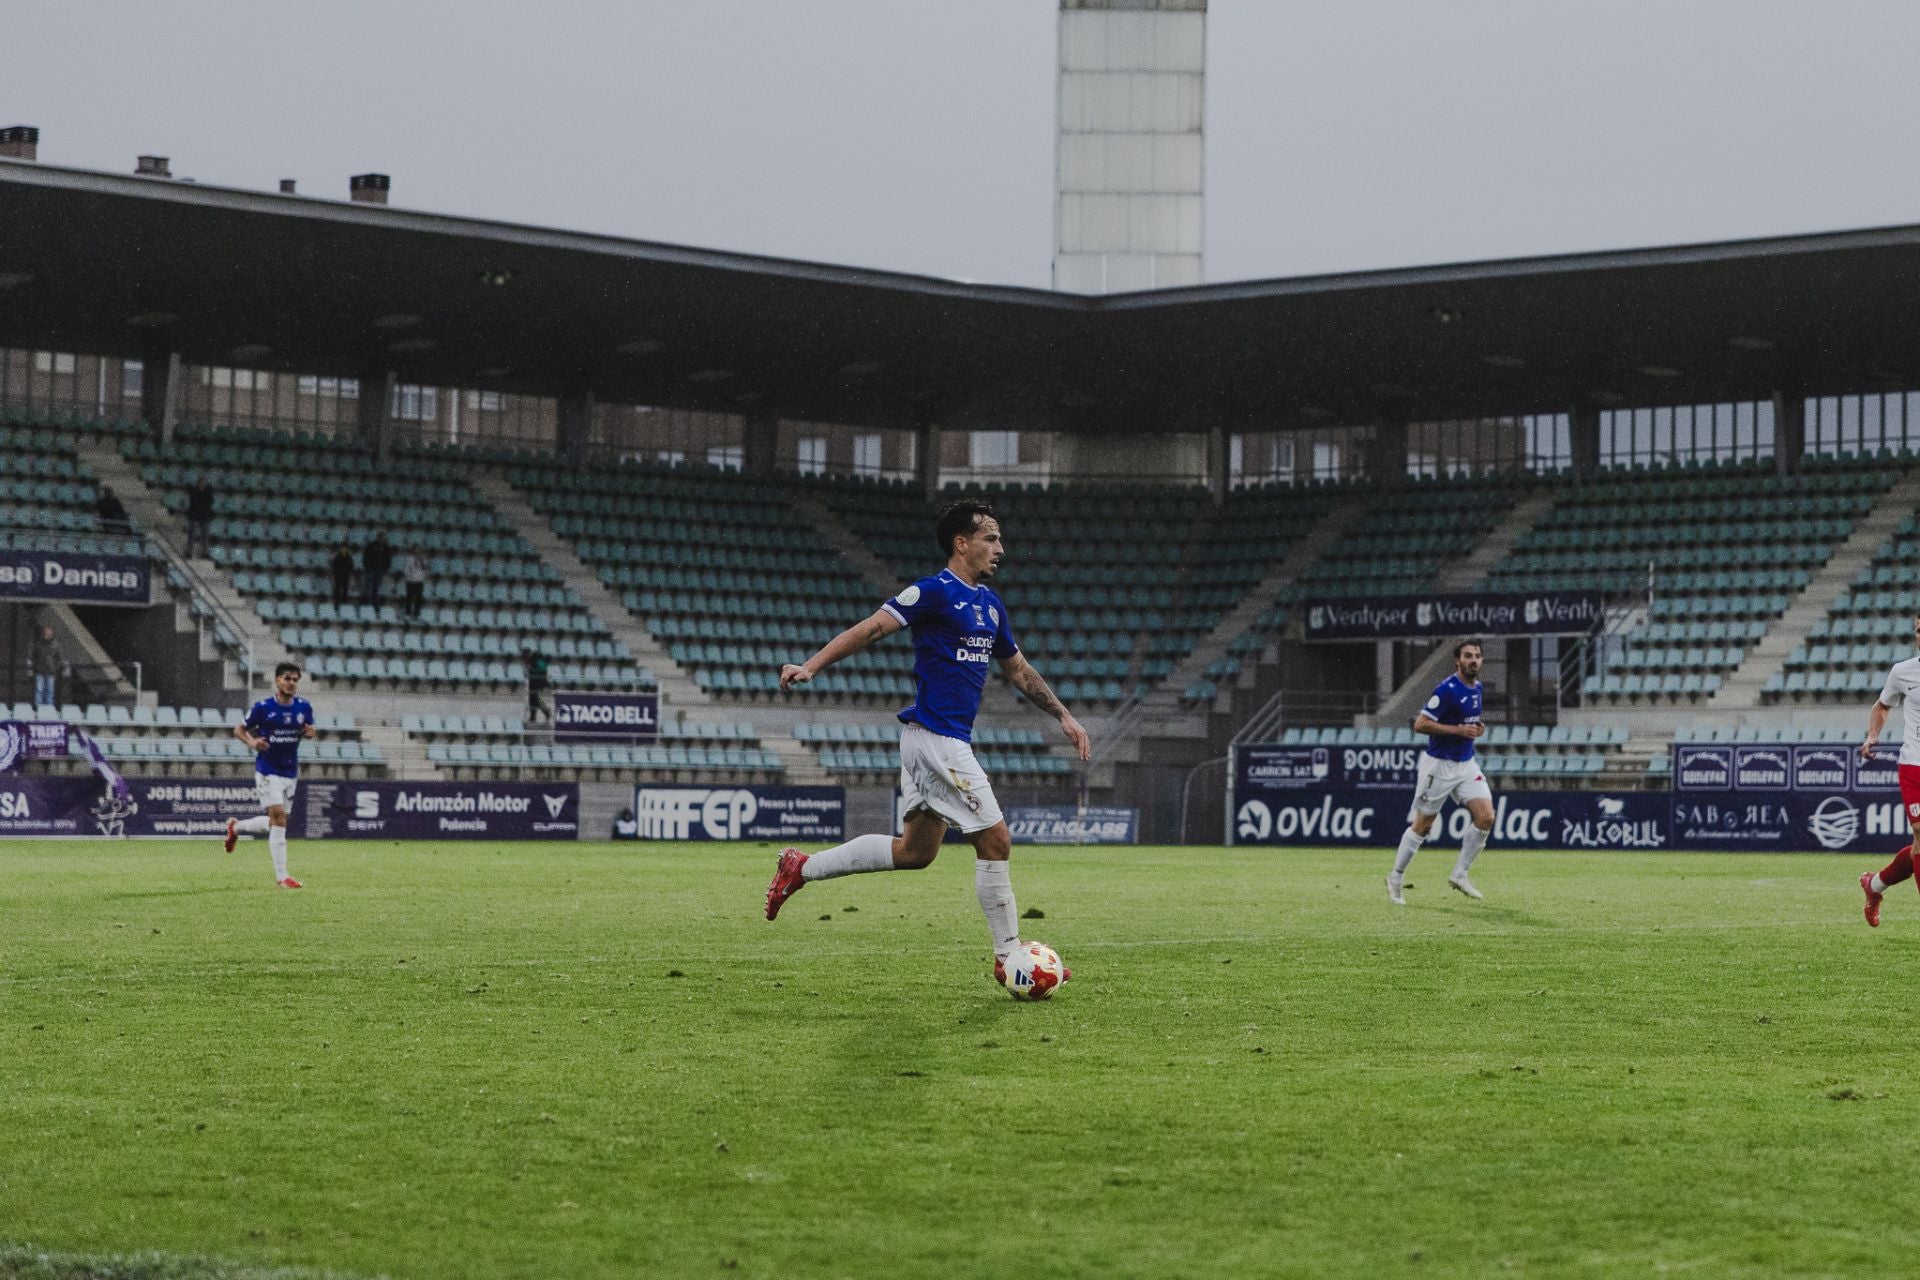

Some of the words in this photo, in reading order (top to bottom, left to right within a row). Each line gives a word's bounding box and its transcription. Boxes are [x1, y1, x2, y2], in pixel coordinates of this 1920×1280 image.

[44, 560, 138, 589] Danisa
[956, 648, 992, 663] Danis
[571, 704, 613, 723] TACO
[614, 705, 654, 724] BELL
[1344, 749, 1418, 770] DOMUS
[219, 801, 261, 814] Generale
[395, 791, 475, 812] Arlanzón
[478, 792, 531, 812] Motor
[439, 817, 487, 831] Palencia
[1277, 794, 1374, 839] ovlac
[1449, 796, 1552, 841] olac
